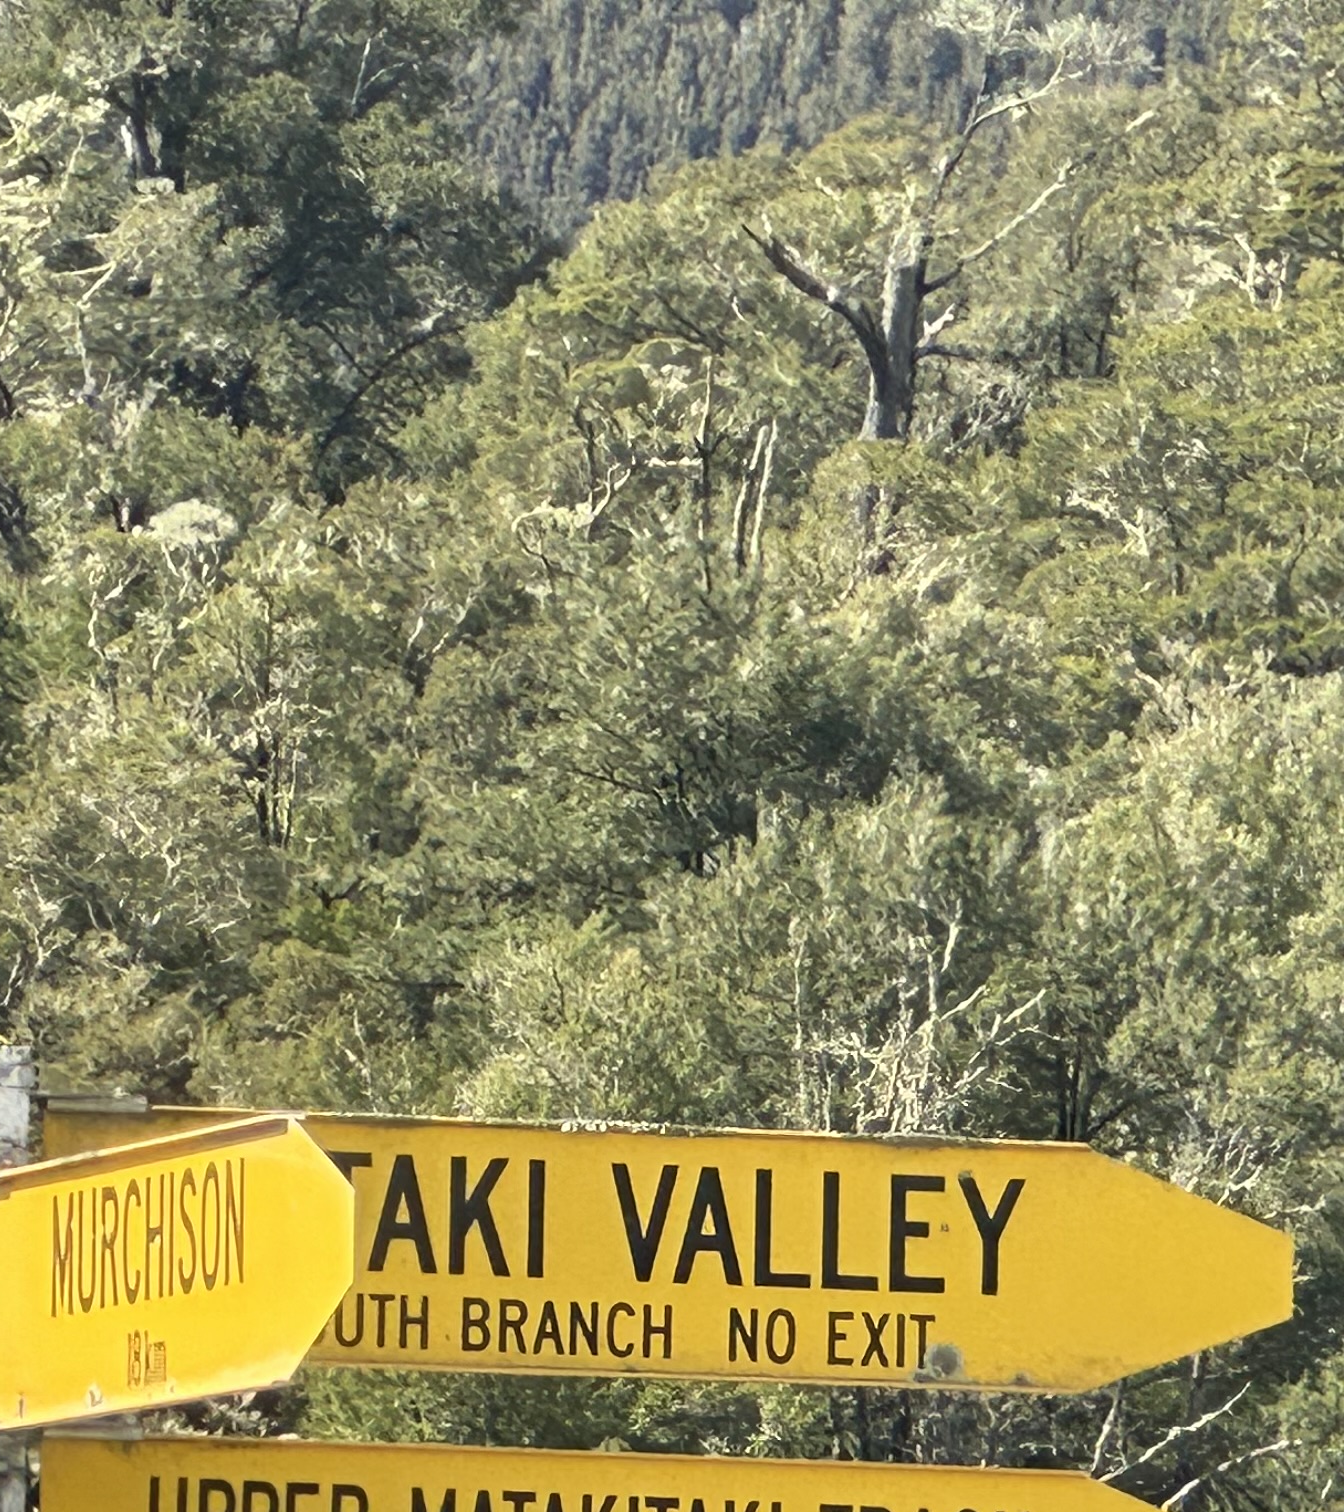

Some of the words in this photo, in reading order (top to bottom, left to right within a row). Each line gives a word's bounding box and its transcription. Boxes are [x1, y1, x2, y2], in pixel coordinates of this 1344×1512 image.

[51, 1157, 245, 1318] MURCHISON
[611, 1162, 1026, 1297] VALLEY
[127, 1329, 167, 1388] 18km
[314, 1293, 429, 1350] UTH
[461, 1296, 673, 1360] BRANCH
[728, 1307, 796, 1365] NO
[826, 1311, 936, 1371] EXIT
